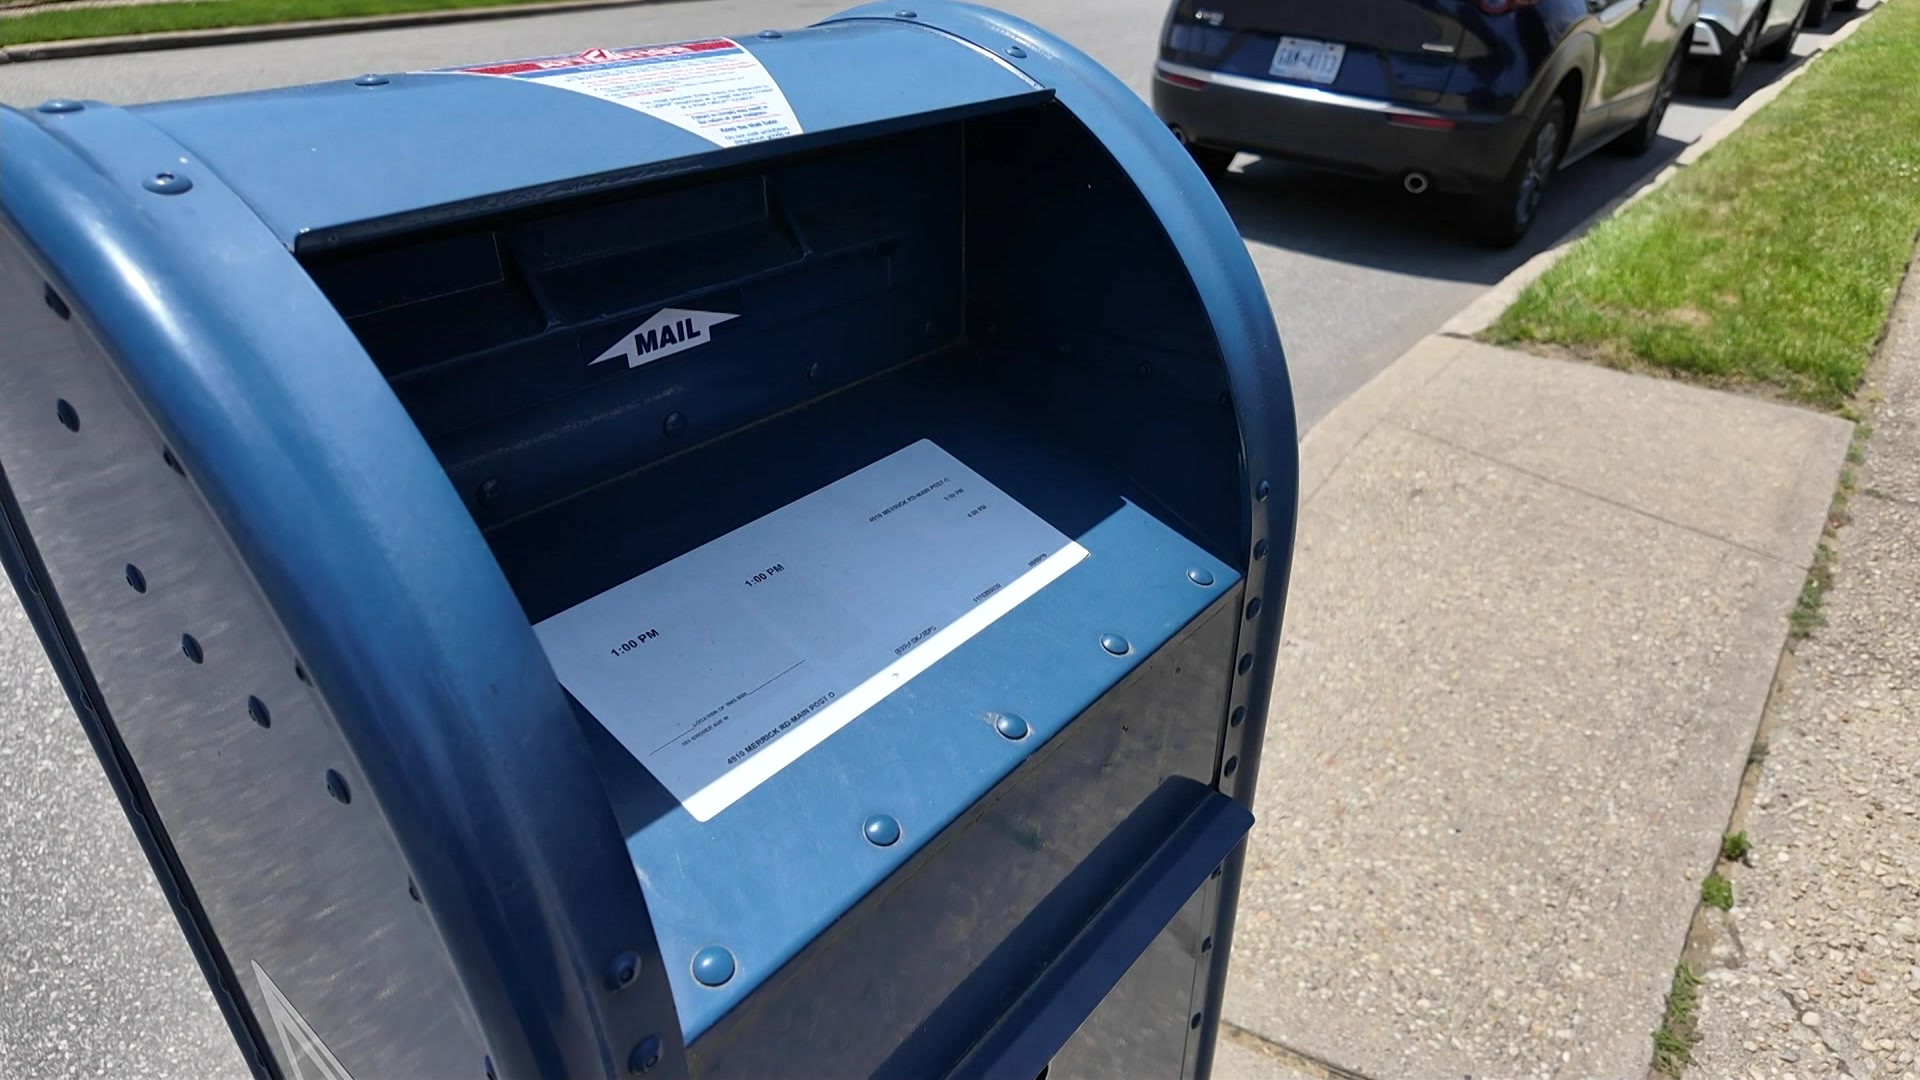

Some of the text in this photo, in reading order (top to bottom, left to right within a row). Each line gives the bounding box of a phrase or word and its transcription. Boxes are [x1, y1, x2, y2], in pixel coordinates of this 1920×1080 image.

[634, 318, 701, 356] MAIL
[882, 499, 908, 516] MERRICK
[744, 563, 785, 587] 1:00 PM
[610, 628, 660, 657] 1:00 PM
[727, 750, 745, 765] 4910
[744, 727, 780, 753] MERRICK
[779, 708, 810, 731] RD-MAIN
[808, 695, 828, 711] POST
